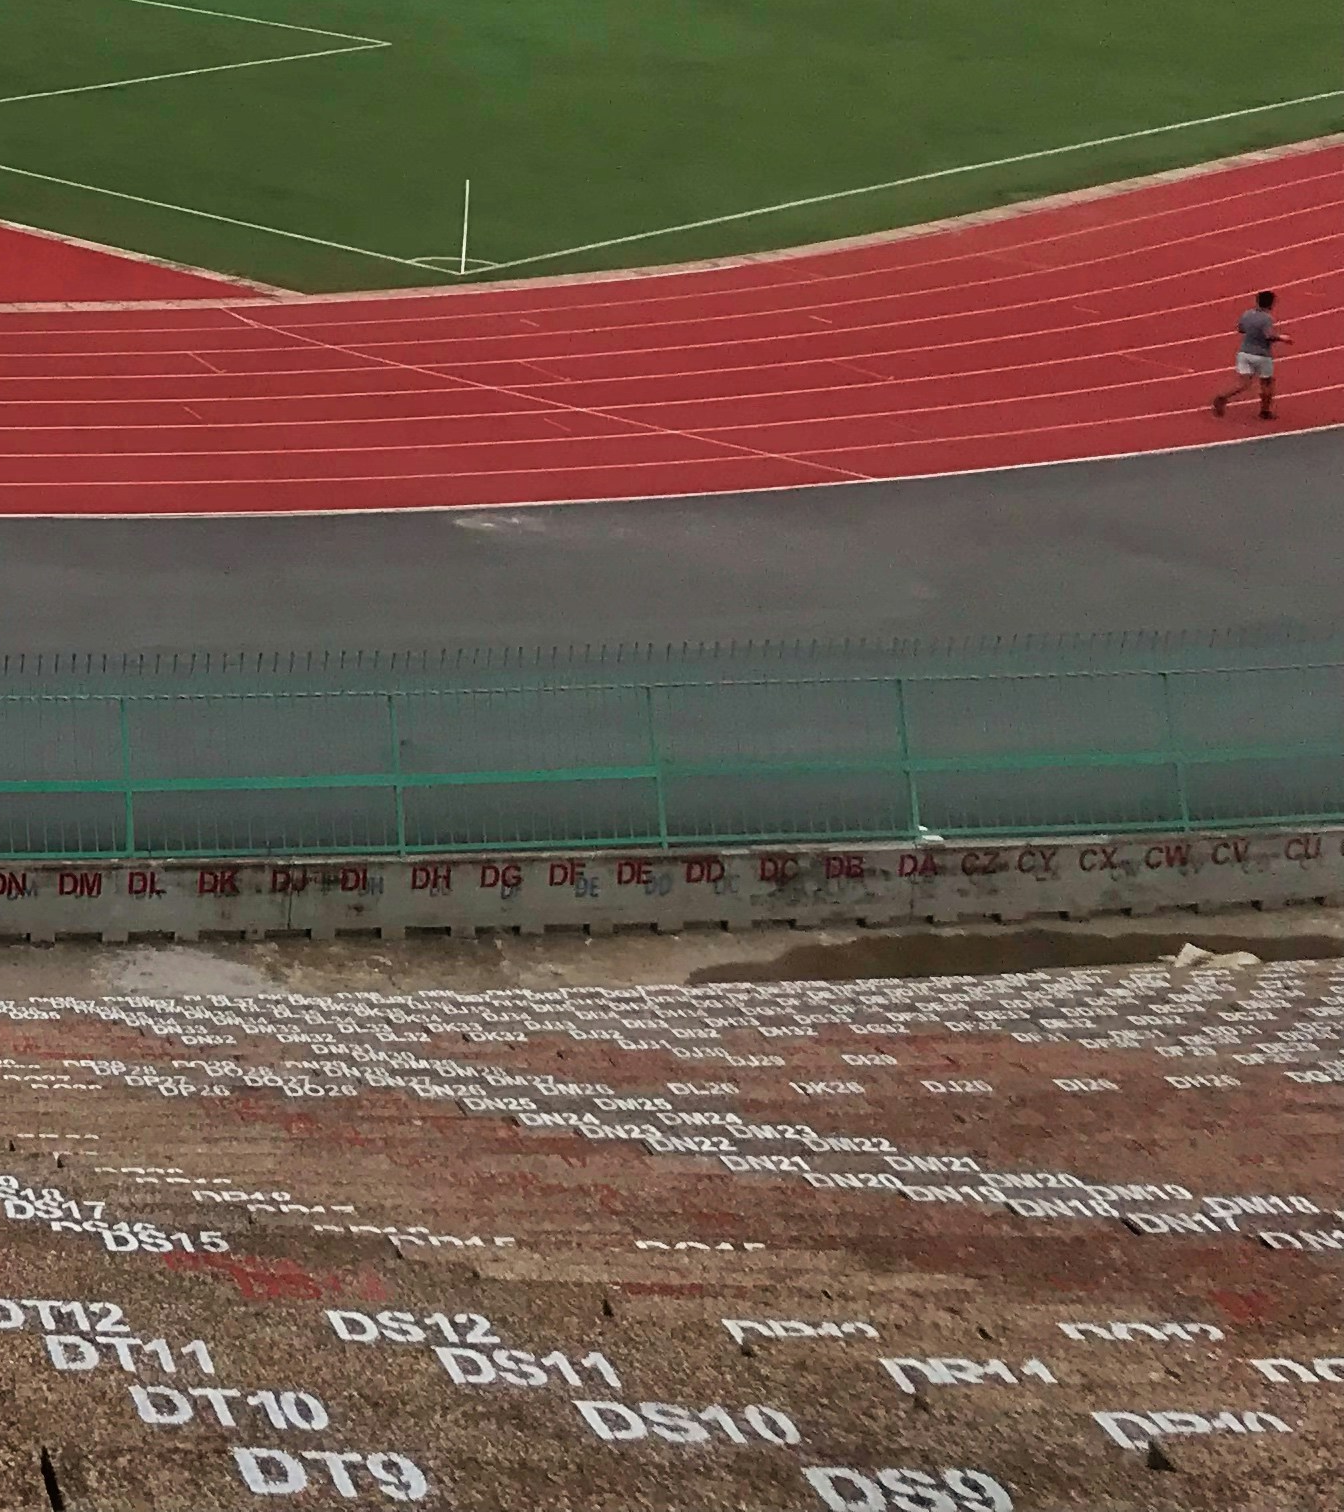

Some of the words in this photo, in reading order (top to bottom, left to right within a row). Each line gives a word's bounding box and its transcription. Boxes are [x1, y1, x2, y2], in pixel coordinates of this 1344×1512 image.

[58, 871, 102, 896] DM
[411, 867, 451, 891] DH
[480, 865, 522, 889] DG
[549, 863, 587, 887] DF
[617, 859, 654, 885] DE
[686, 857, 725, 883] DD
[898, 854, 939, 877] DA
[1018, 850, 1056, 874] CY
[1079, 847, 1119, 872] CX
[1145, 845, 1191, 870] CW
[1213, 839, 1250, 866] CV
[464, 1097, 537, 1111] DN25
[593, 1098, 672, 1111] DM25
[518, 1112, 600, 1126] DN24
[657, 1112, 743, 1125] DM24
[579, 1125, 664, 1139] DN23
[726, 1125, 818, 1139] DM23
[644, 1137, 737, 1153] DN22
[802, 1138, 897, 1153] DM22
[719, 1155, 811, 1172] DN21
[884, 1156, 981, 1173] DM21
[804, 1173, 903, 1189] DN20
[902, 1185, 1006, 1203] DN19
[1084, 1185, 1193, 1201] DM19
[3, 1200, 106, 1220] DS17
[1009, 1198, 1120, 1218] DN18
[1202, 1195, 1322, 1215] DM18
[101, 1230, 229, 1253] DS15
[324, 1308, 501, 1345] DS12
[44, 1336, 215, 1374] DT11
[433, 1345, 623, 1388] DS11
[128, 1386, 330, 1430] DT10
[572, 1399, 803, 1445] DS10
[231, 1446, 430, 1502] DT9
[802, 1466, 1014, 1512] DS9
